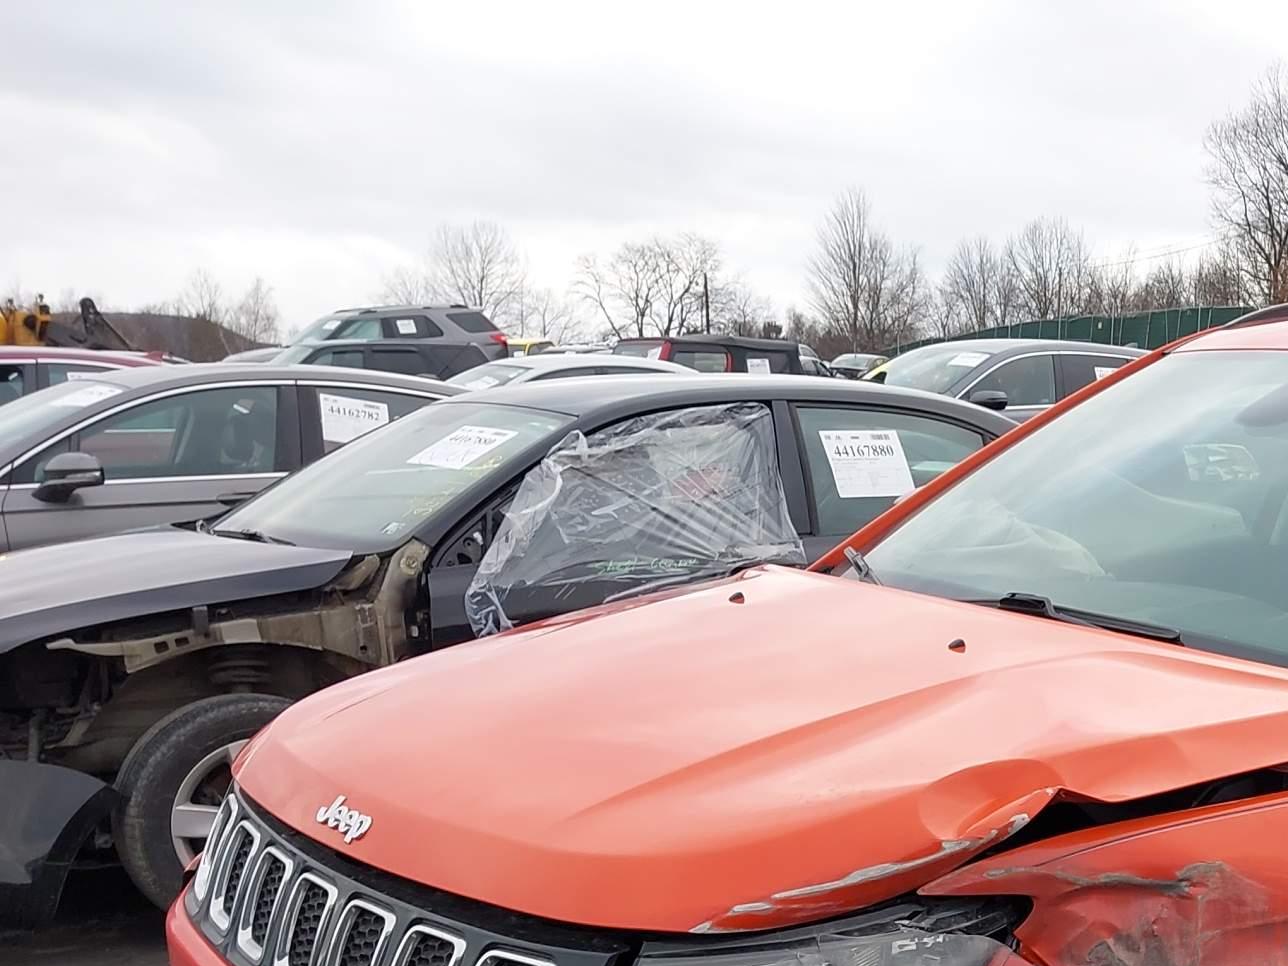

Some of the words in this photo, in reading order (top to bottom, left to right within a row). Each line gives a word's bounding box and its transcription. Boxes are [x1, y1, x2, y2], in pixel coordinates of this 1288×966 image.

[327, 405, 381, 421] 44162782
[833, 444, 895, 457] 44167880
[316, 794, 373, 845] Jeep
